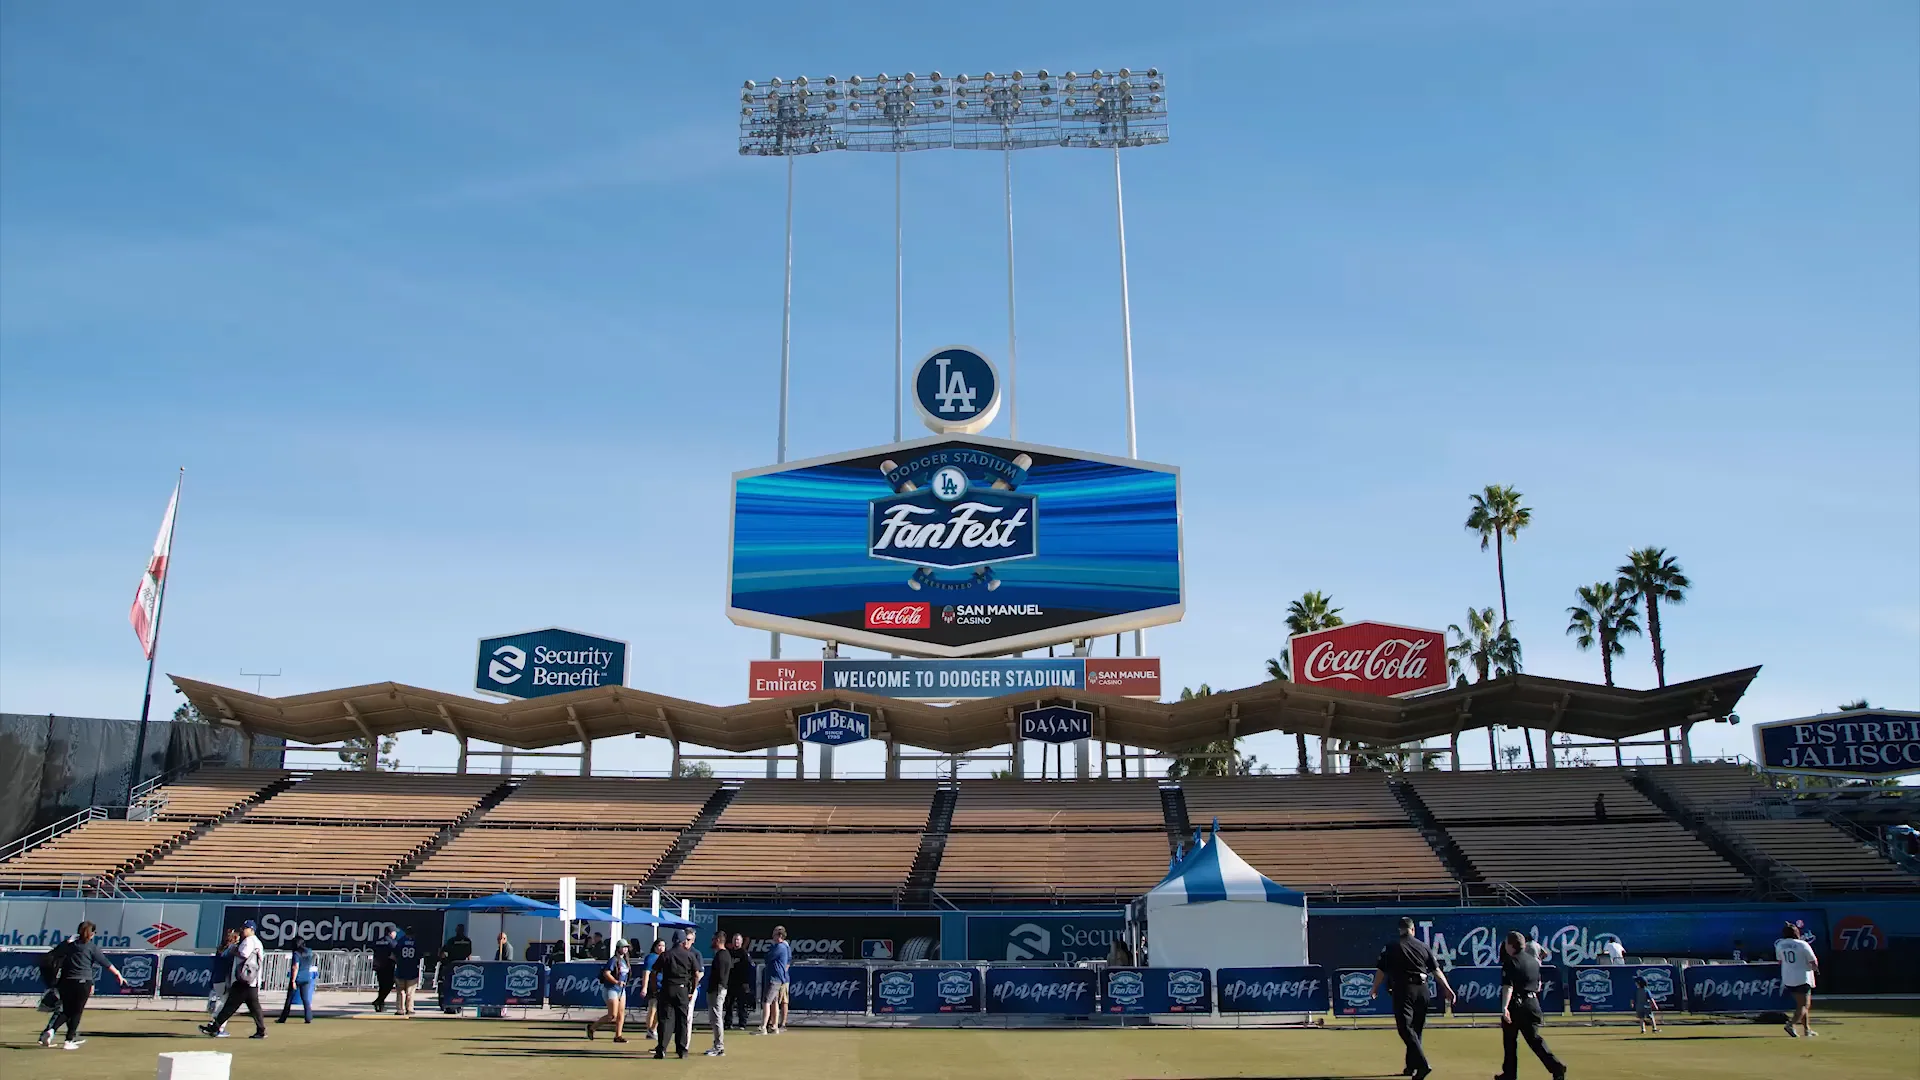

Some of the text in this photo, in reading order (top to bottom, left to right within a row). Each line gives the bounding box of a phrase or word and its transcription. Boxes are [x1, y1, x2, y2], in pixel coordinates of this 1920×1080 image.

[935, 359, 977, 412] LA
[889, 452, 1018, 483] DODGER STADIUM
[941, 473, 958, 494] LA
[872, 502, 1028, 549] FanFest
[918, 575, 972, 591] PRESENTED
[870, 606, 924, 625] Coca-Cola
[957, 604, 1043, 616] SAN MANUEL
[957, 616, 992, 625] CASINO
[534, 645, 613, 669] Security
[1304, 638, 1434, 682] Coca-Cola
[532, 667, 601, 687] Benefit
[778, 668, 796, 679] Fly
[833, 669, 1076, 688] WELCOME TO DODGER STADIUM
[1098, 670, 1158, 679] SAN MANUEL
[756, 678, 817, 691] Emirates
[802, 711, 867, 739] JIM BEAM
[1025, 714, 1088, 736] DASANI
[695, 914, 714, 924] 375
[260, 913, 397, 947] Spectrum
[1061, 924, 1125, 946] Secur
[26, 929, 48, 946] of
[51, 930, 131, 947] Arica
[1838, 925, 1879, 951] 76
[402, 946, 415, 959] 88
[1783, 950, 1796, 964] 10
[454, 976, 482, 988] FanFest
[508, 976, 537, 988] FanFest
[882, 984, 912, 995] FanFest
[941, 983, 970, 994] FanFest
[1111, 983, 1140, 995] FanFest
[1171, 983, 1201, 994] FanFest
[1580, 982, 1609, 993] FanFest
[1343, 985, 1372, 996] FanFest
